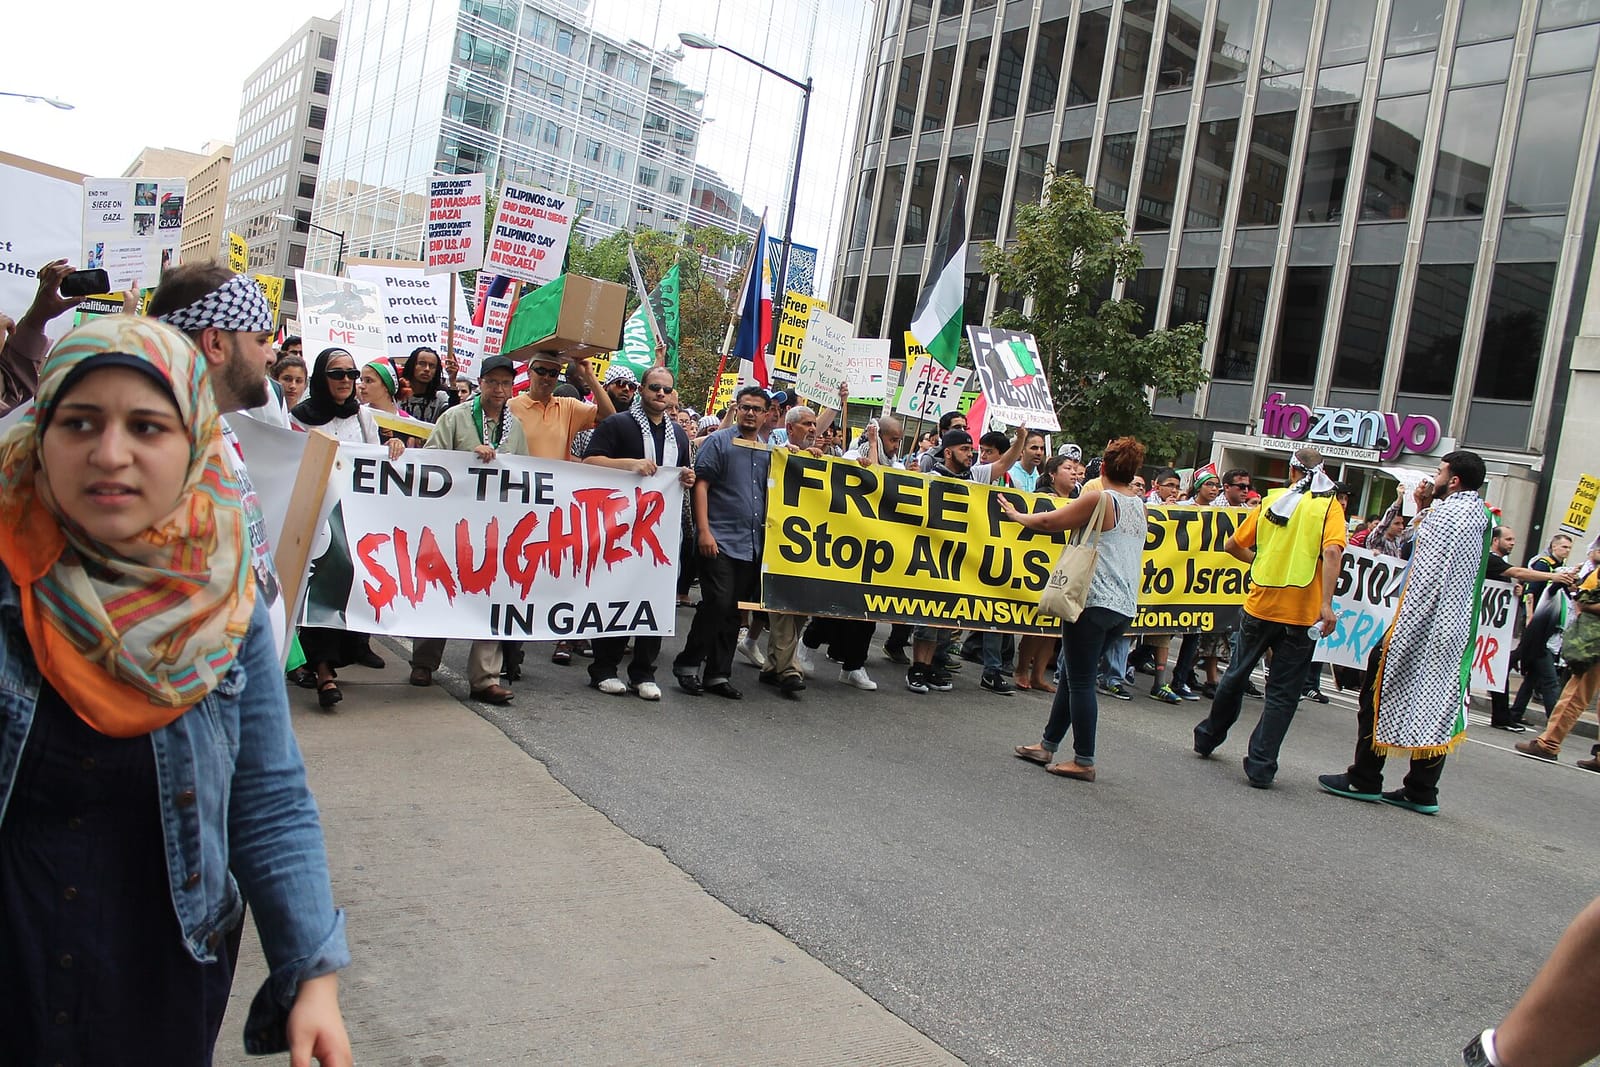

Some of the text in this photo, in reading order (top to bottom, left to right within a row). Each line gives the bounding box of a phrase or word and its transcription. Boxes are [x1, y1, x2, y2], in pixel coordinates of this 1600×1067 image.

[454, 188, 464, 196] SAY
[506, 187, 565, 210] FILIPINOS SAY
[92, 200, 122, 208] SIEGE ON
[430, 195, 481, 209] END MASSACRE
[430, 210, 462, 220] IN GAZA!
[500, 213, 534, 228] IN GAZA!
[502, 200, 568, 224] END ISRAELI SIEGE
[159, 218, 181, 228] GAZA
[430, 238, 472, 252] END U.S. AID
[496, 226, 556, 248] FILIPINOS SAY
[429, 252, 466, 266] IN ISRAEL!
[494, 239, 546, 260] END U.S. AID
[490, 251, 502, 262] IN
[502, 254, 537, 271] ISRAEL!
[386, 276, 430, 288] Please
[388, 296, 438, 308] protect
[785, 296, 808, 314] Free
[308, 315, 382, 334] IT COULD BE
[810, 309, 821, 331] 7
[329, 328, 356, 344] ME
[387, 332, 402, 344] nd
[778, 333, 795, 349] LET
[824, 326, 846, 345] YEARS
[811, 335, 846, 356] HOLOCAUST
[852, 343, 872, 352] THE
[780, 350, 801, 369] LIV
[720, 378, 734, 386] Free
[800, 359, 816, 378] 67
[818, 371, 841, 390] YEARS
[920, 364, 952, 384] FREE
[915, 380, 948, 398] FREE
[980, 368, 1053, 412] PALESTINE
[909, 396, 942, 418] GAZA
[1262, 439, 1291, 448] DELICIOUS
[1326, 448, 1350, 456] FROZEN
[1350, 450, 1376, 458] YOGURT
[352, 458, 554, 506] END THE
[1579, 477, 1596, 490] Free
[783, 454, 971, 534] FREE
[1570, 502, 1582, 510] LET
[356, 487, 672, 624] SLAUGHTER
[778, 516, 1252, 595] Stop All U.S to Israe
[490, 600, 658, 636] IN GAZA
